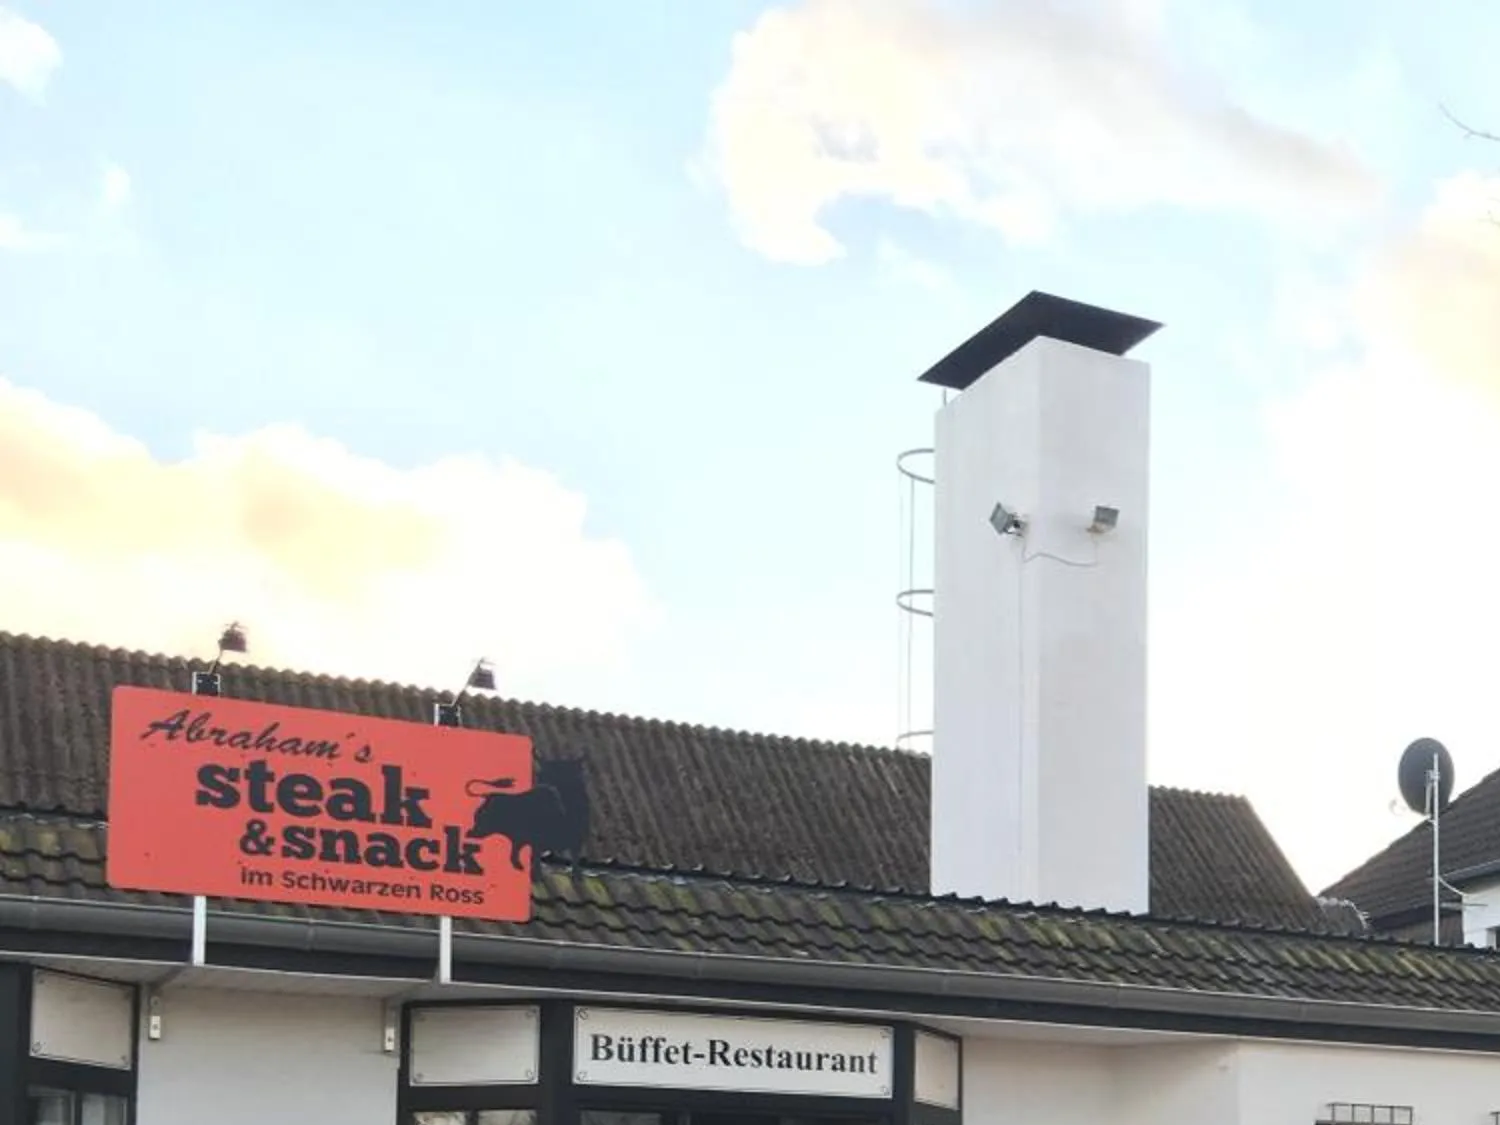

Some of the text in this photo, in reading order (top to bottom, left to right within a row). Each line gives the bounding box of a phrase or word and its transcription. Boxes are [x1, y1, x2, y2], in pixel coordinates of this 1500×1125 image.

[195, 758, 432, 828] steak
[240, 866, 485, 905] im Schwarzen Ross
[589, 1033, 878, 1075] Büffet-Restaurant
